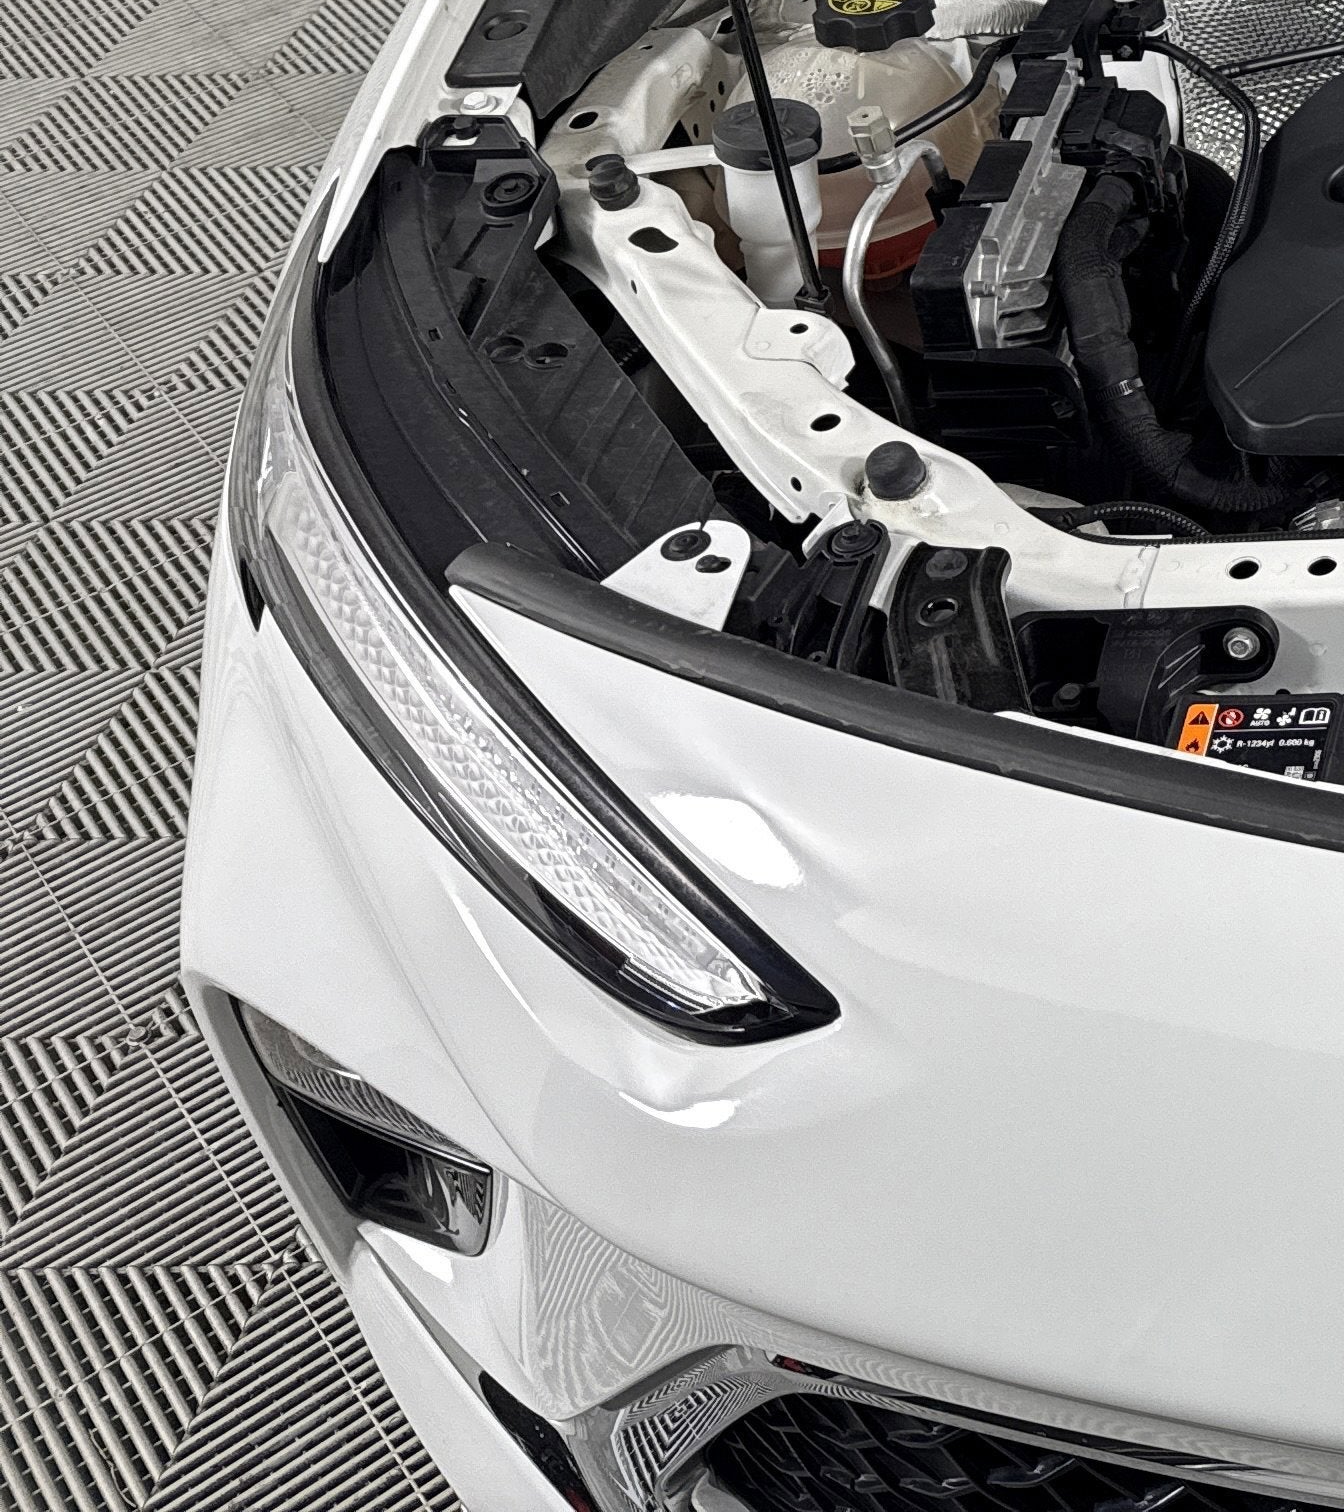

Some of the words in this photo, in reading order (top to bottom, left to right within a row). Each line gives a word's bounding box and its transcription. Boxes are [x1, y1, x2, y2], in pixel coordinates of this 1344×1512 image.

[1249, 719, 1271, 727] AUTO
[1235, 738, 1275, 748] R-1234yf
[1303, 738, 1315, 747] kg
